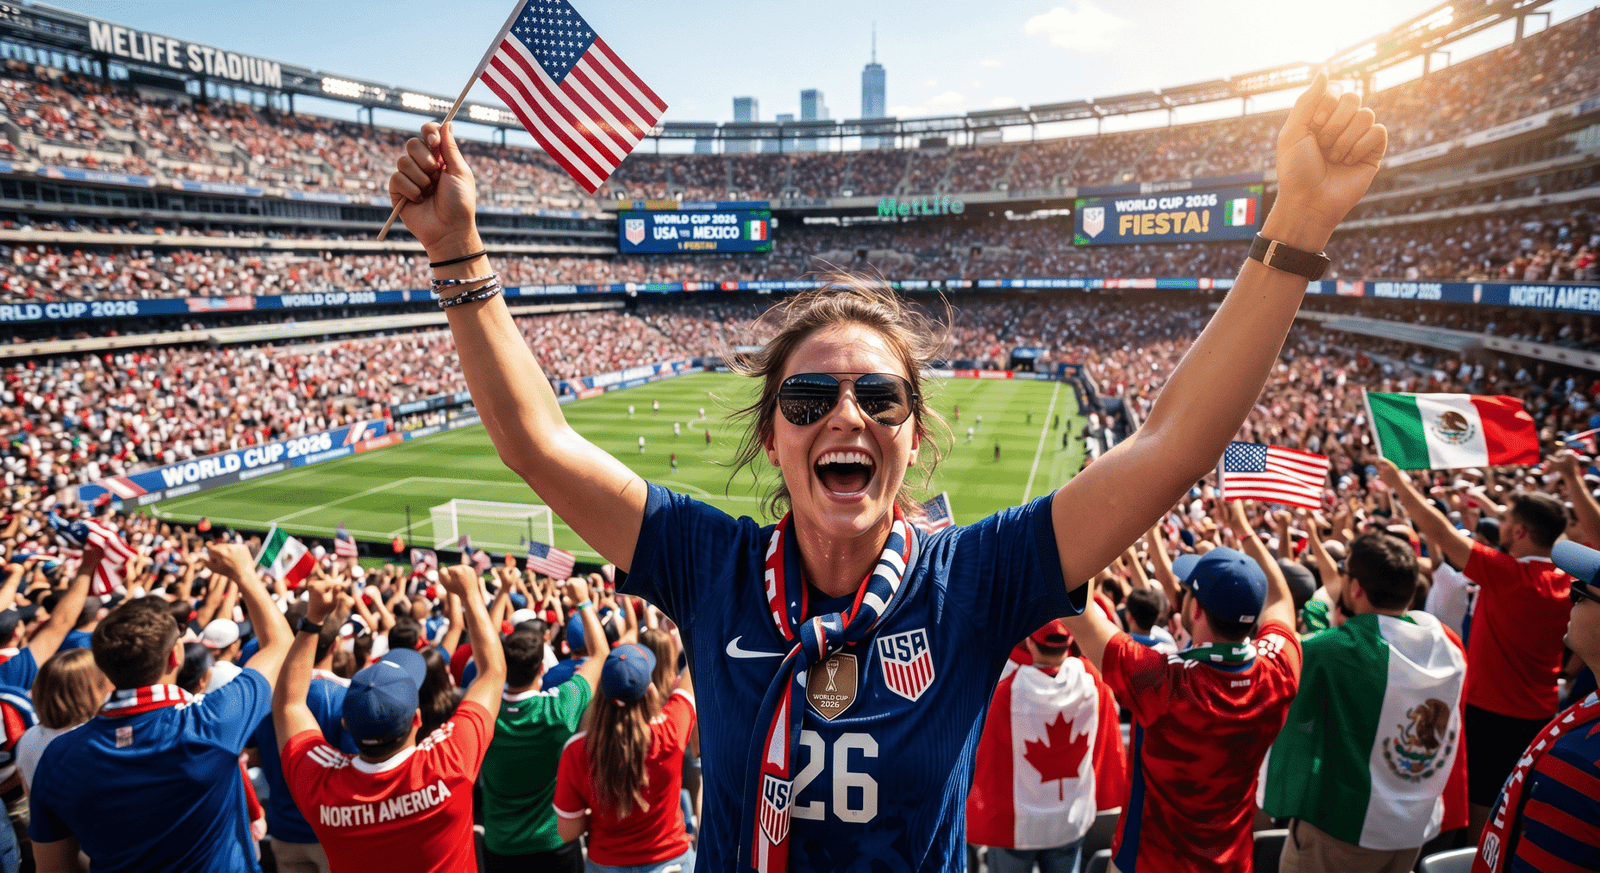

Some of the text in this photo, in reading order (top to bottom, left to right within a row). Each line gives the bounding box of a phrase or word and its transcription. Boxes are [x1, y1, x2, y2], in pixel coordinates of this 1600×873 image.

[88, 20, 282, 88] MELIFE STADIUM
[1115, 193, 1218, 212] WORLD CUP 2026
[653, 214, 737, 224] WORLD CUP 2026
[1119, 210, 1210, 236] FIESTA!
[653, 226, 678, 240] USA
[692, 226, 740, 240] MEXICO
[325, 292, 348, 305] CUP
[1508, 285, 1555, 308] NORTH
[45, 302, 88, 319] CUP
[91, 301, 139, 317] 2026
[161, 453, 241, 488] WORLD
[243, 443, 284, 468] CUP
[286, 432, 332, 459] 2026
[879, 631, 926, 663] USA
[791, 729, 879, 824] 26
[320, 780, 452, 827] NORTH AMERICA
[765, 778, 794, 811] US
